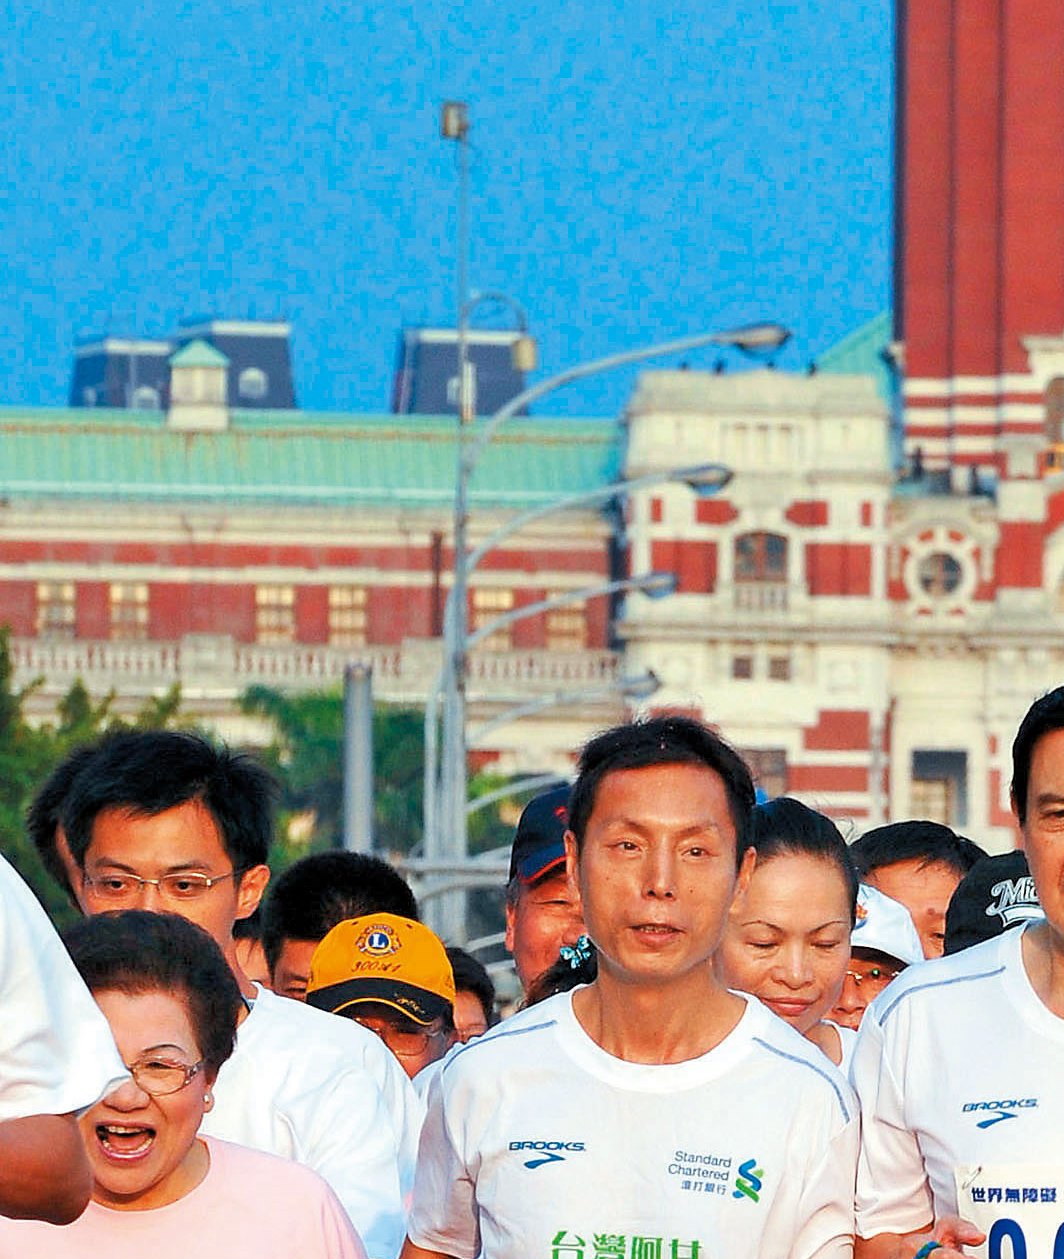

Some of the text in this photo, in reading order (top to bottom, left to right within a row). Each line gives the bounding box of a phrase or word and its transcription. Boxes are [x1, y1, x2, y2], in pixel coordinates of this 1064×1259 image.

[961, 1098, 1038, 1113] BROOKS
[509, 1140, 586, 1151] BROOKS
[674, 1150, 732, 1168] Standard
[668, 1164, 730, 1181] Chartered
[681, 1180, 727, 1195] 渣打銀行
[971, 1187, 1057, 1203] 世界無障礙
